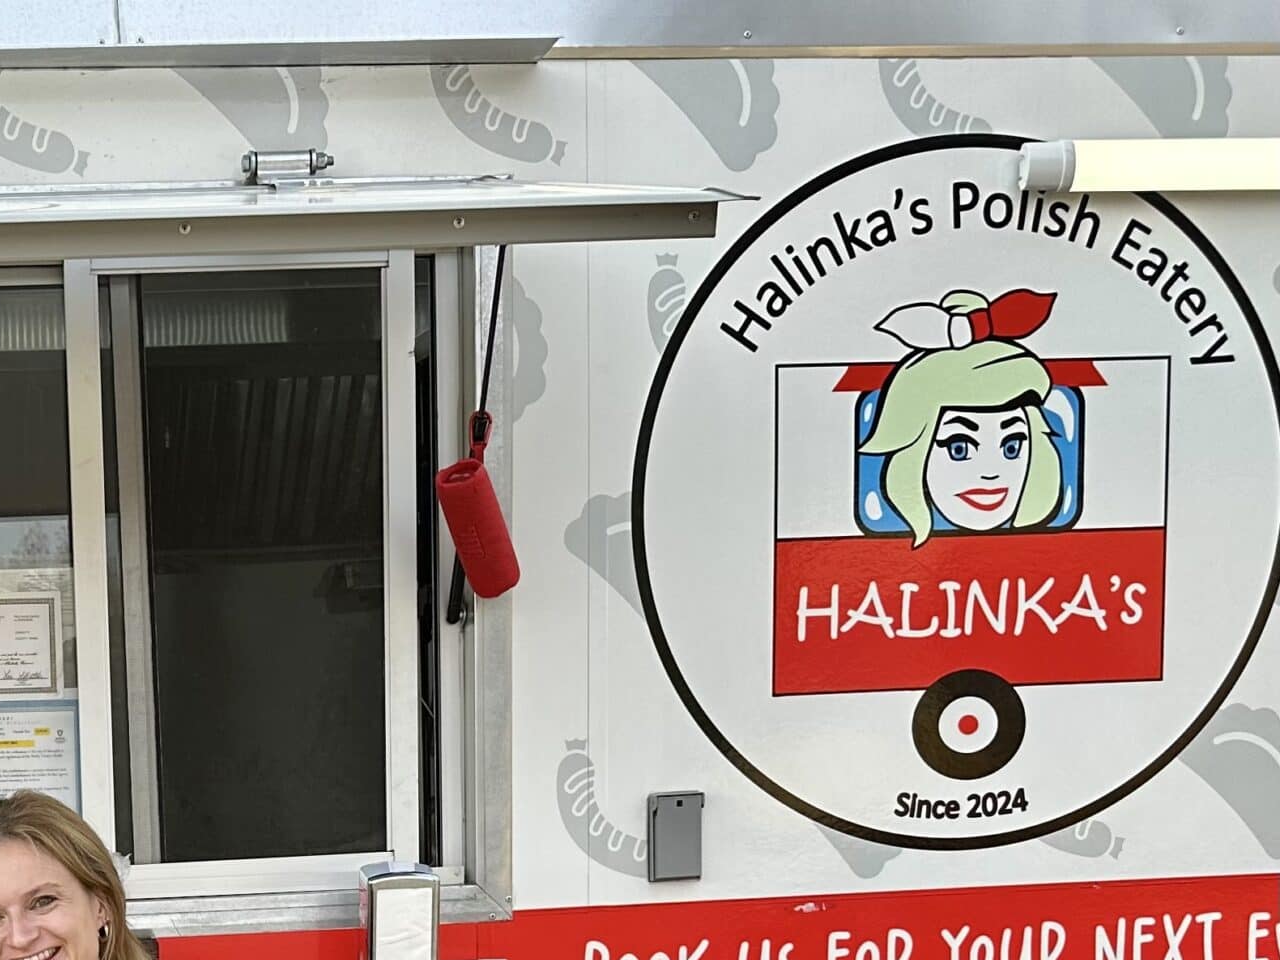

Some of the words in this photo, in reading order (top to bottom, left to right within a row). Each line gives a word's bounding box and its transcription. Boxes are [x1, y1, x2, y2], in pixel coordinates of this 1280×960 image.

[719, 188, 933, 352] Halinka's
[952, 181, 1102, 249] Polish
[1111, 218, 1236, 366] Eatery
[894, 792, 961, 820] Since
[966, 788, 1029, 818] 2024
